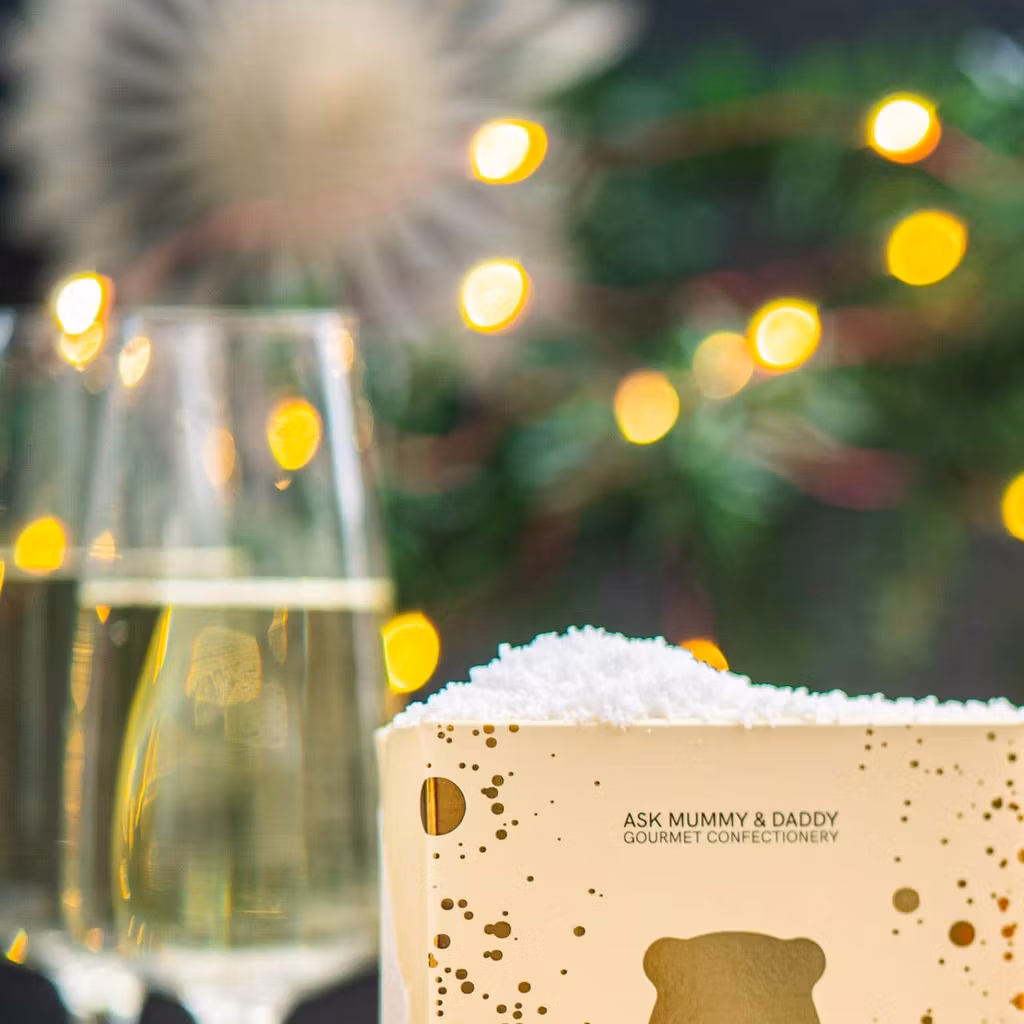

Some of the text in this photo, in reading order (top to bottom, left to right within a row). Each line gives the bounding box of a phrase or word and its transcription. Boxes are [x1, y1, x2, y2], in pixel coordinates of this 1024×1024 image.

[623, 811, 839, 828] ASK MUMMY & DADDY
[623, 830, 839, 844] GOURMET CONFECTIONERY
